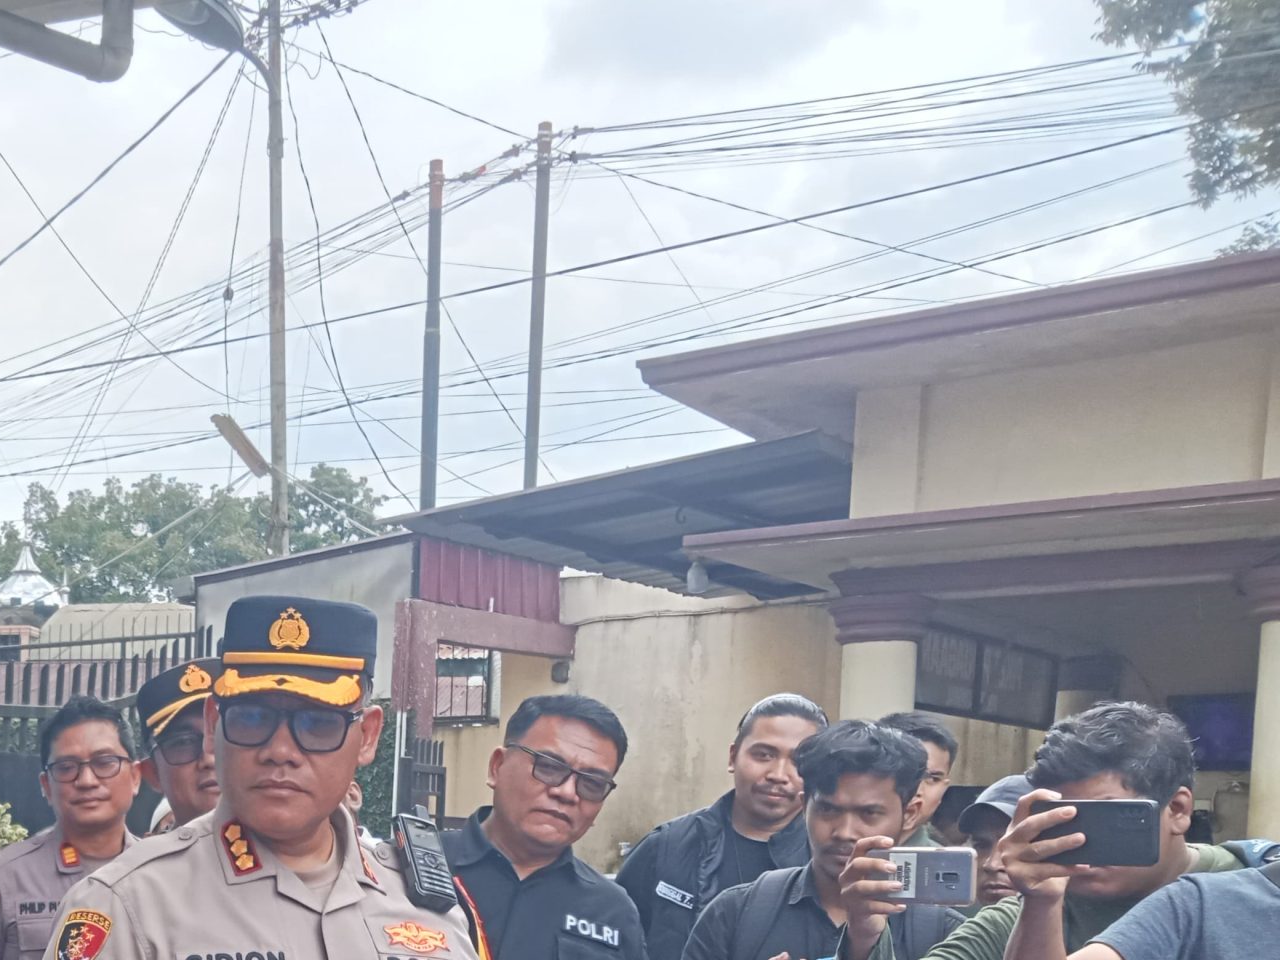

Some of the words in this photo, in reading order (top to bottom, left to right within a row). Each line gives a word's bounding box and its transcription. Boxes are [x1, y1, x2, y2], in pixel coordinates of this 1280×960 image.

[19, 903, 46, 915] PHILIP
[70, 912, 110, 930] RESERSE
[565, 914, 619, 946] POLRI
